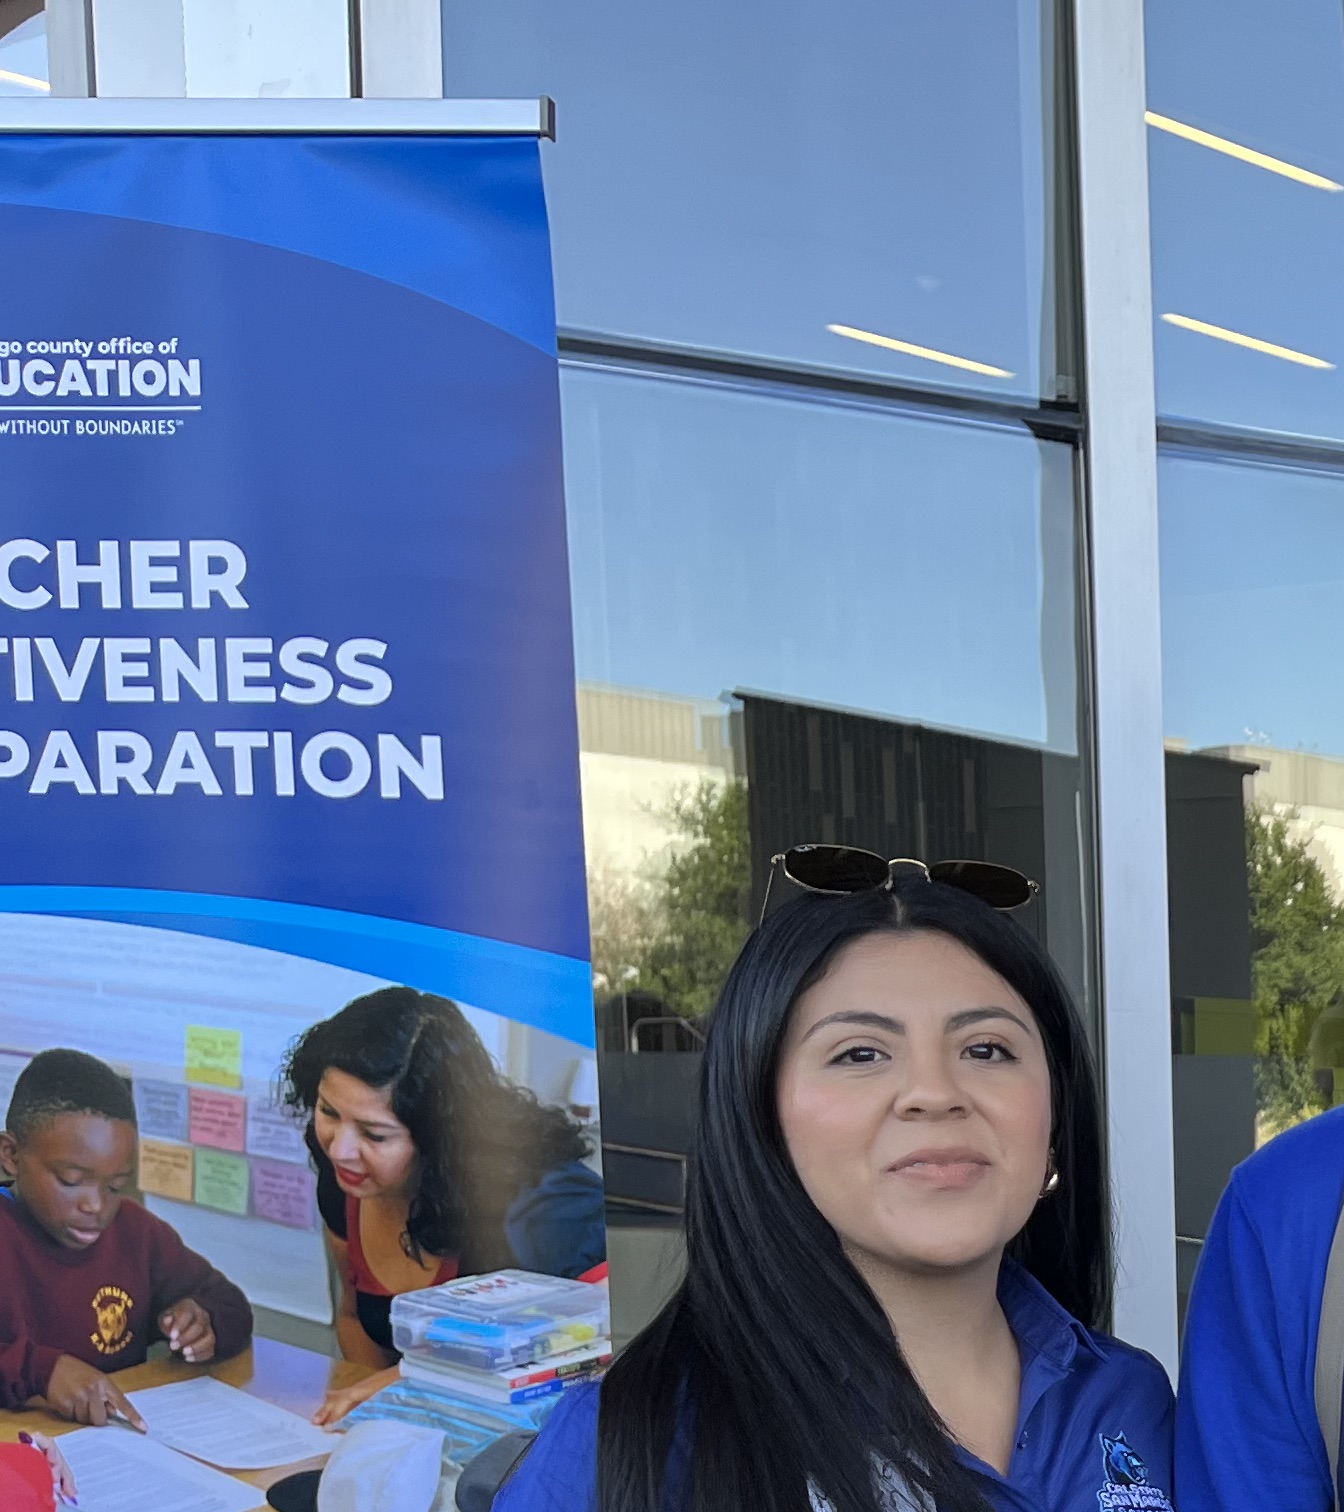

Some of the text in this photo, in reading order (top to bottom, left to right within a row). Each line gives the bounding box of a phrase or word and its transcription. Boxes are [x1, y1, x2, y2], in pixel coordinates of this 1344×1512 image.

[26, 338, 93, 357] county
[98, 337, 154, 354] office
[158, 337, 178, 354] of
[0, 358, 201, 396] UCATION
[0, 419, 176, 435] WITHOUT BOUNDARIES
[0, 538, 249, 611] CHER
[0, 636, 393, 707] IVENESS
